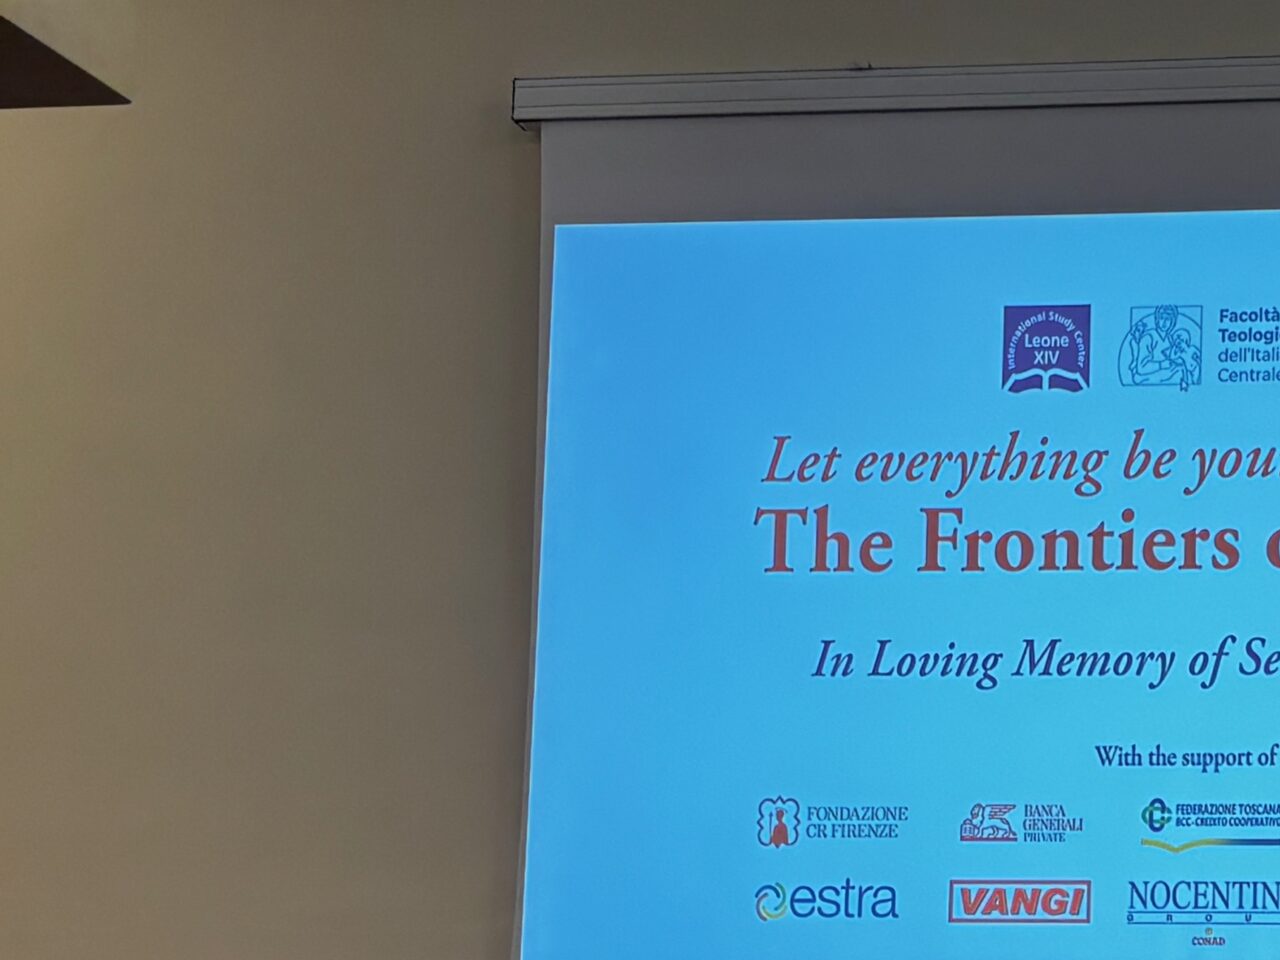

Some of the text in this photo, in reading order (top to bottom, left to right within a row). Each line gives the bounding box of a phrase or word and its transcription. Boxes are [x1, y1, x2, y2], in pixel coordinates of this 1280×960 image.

[1219, 306, 1280, 323] Facoltà
[1007, 310, 1087, 370] International Study Center
[1024, 333, 1070, 348] Leone
[1033, 350, 1060, 365] XIV
[760, 435, 842, 484] Let
[854, 431, 1109, 499] everything
[1122, 428, 1178, 480] be
[754, 504, 894, 573] The
[917, 506, 1241, 572] Frontiers
[811, 639, 855, 678] In
[867, 639, 1004, 691] Loving
[1011, 638, 1176, 691] Memory
[1189, 635, 1237, 690] of
[1094, 743, 1280, 774] With the support of
[806, 806, 909, 822] FONDAZIONE
[1024, 803, 1066, 818] BANCA
[1175, 803, 1237, 816] FEDERAZIONE
[806, 823, 899, 839] CR FIRENZE
[1022, 818, 1083, 832] GENERALI
[1023, 832, 1066, 843] PRIVATE
[789, 878, 899, 919] estra
[960, 887, 1085, 916] VANGI
[1191, 936, 1226, 946] CONAD
